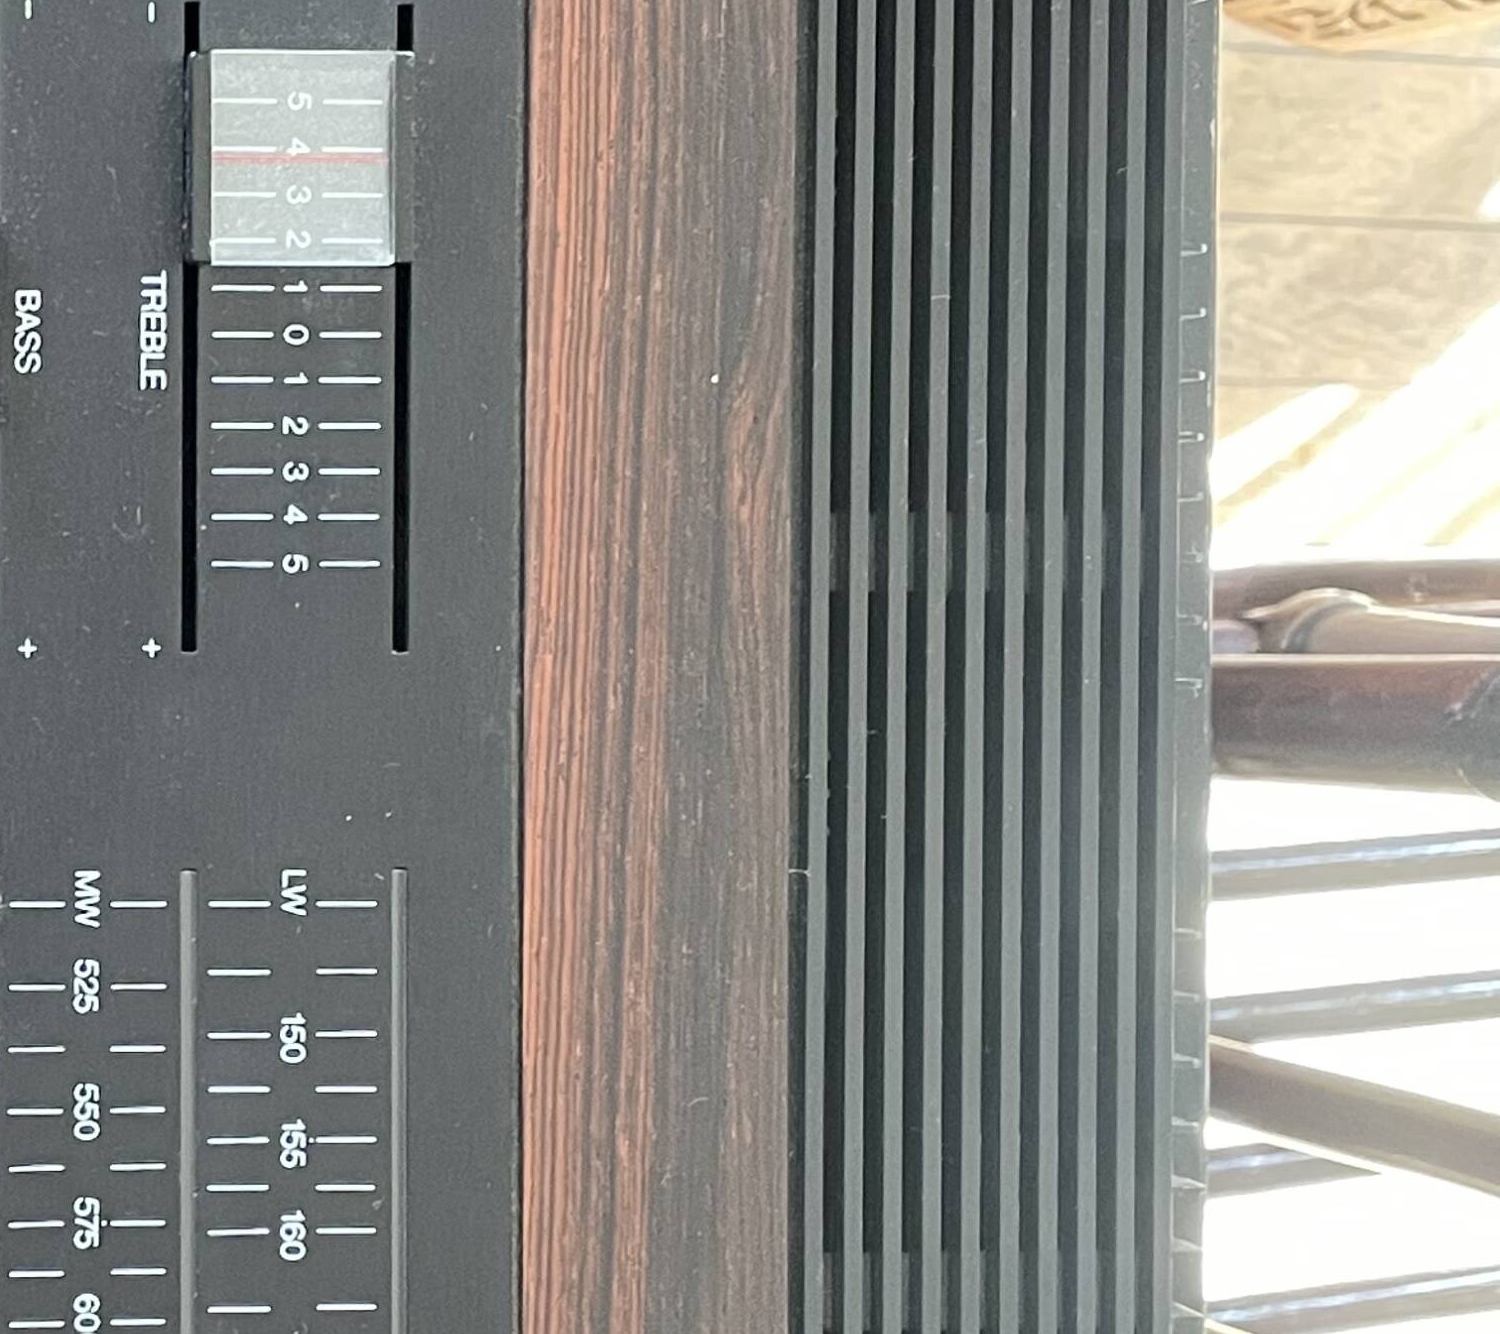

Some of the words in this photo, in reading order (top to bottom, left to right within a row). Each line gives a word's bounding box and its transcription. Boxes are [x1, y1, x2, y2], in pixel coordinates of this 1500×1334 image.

[287, 90, 313, 111] 5
[286, 137, 311, 157] 4
[285, 184, 312, 205] 3
[285, 229, 312, 249] 2
[283, 280, 309, 293] 1
[13, 289, 42, 374] BASS
[139, 269, 167, 391] TREBLE
[282, 324, 310, 346] 0
[283, 372, 309, 384] 1
[282, 415, 310, 435] 2
[282, 461, 310, 482] 3
[283, 504, 308, 525] 4
[282, 553, 309, 574] 5
[74, 870, 101, 928] MW
[280, 869, 307, 916] LW
[72, 959, 100, 1014] 525
[279, 1012, 307, 1064] 150
[73, 1083, 101, 1141] 550
[279, 1118, 307, 1169] 155
[72, 1197, 100, 1250] 575
[279, 1209, 307, 1261] 160
